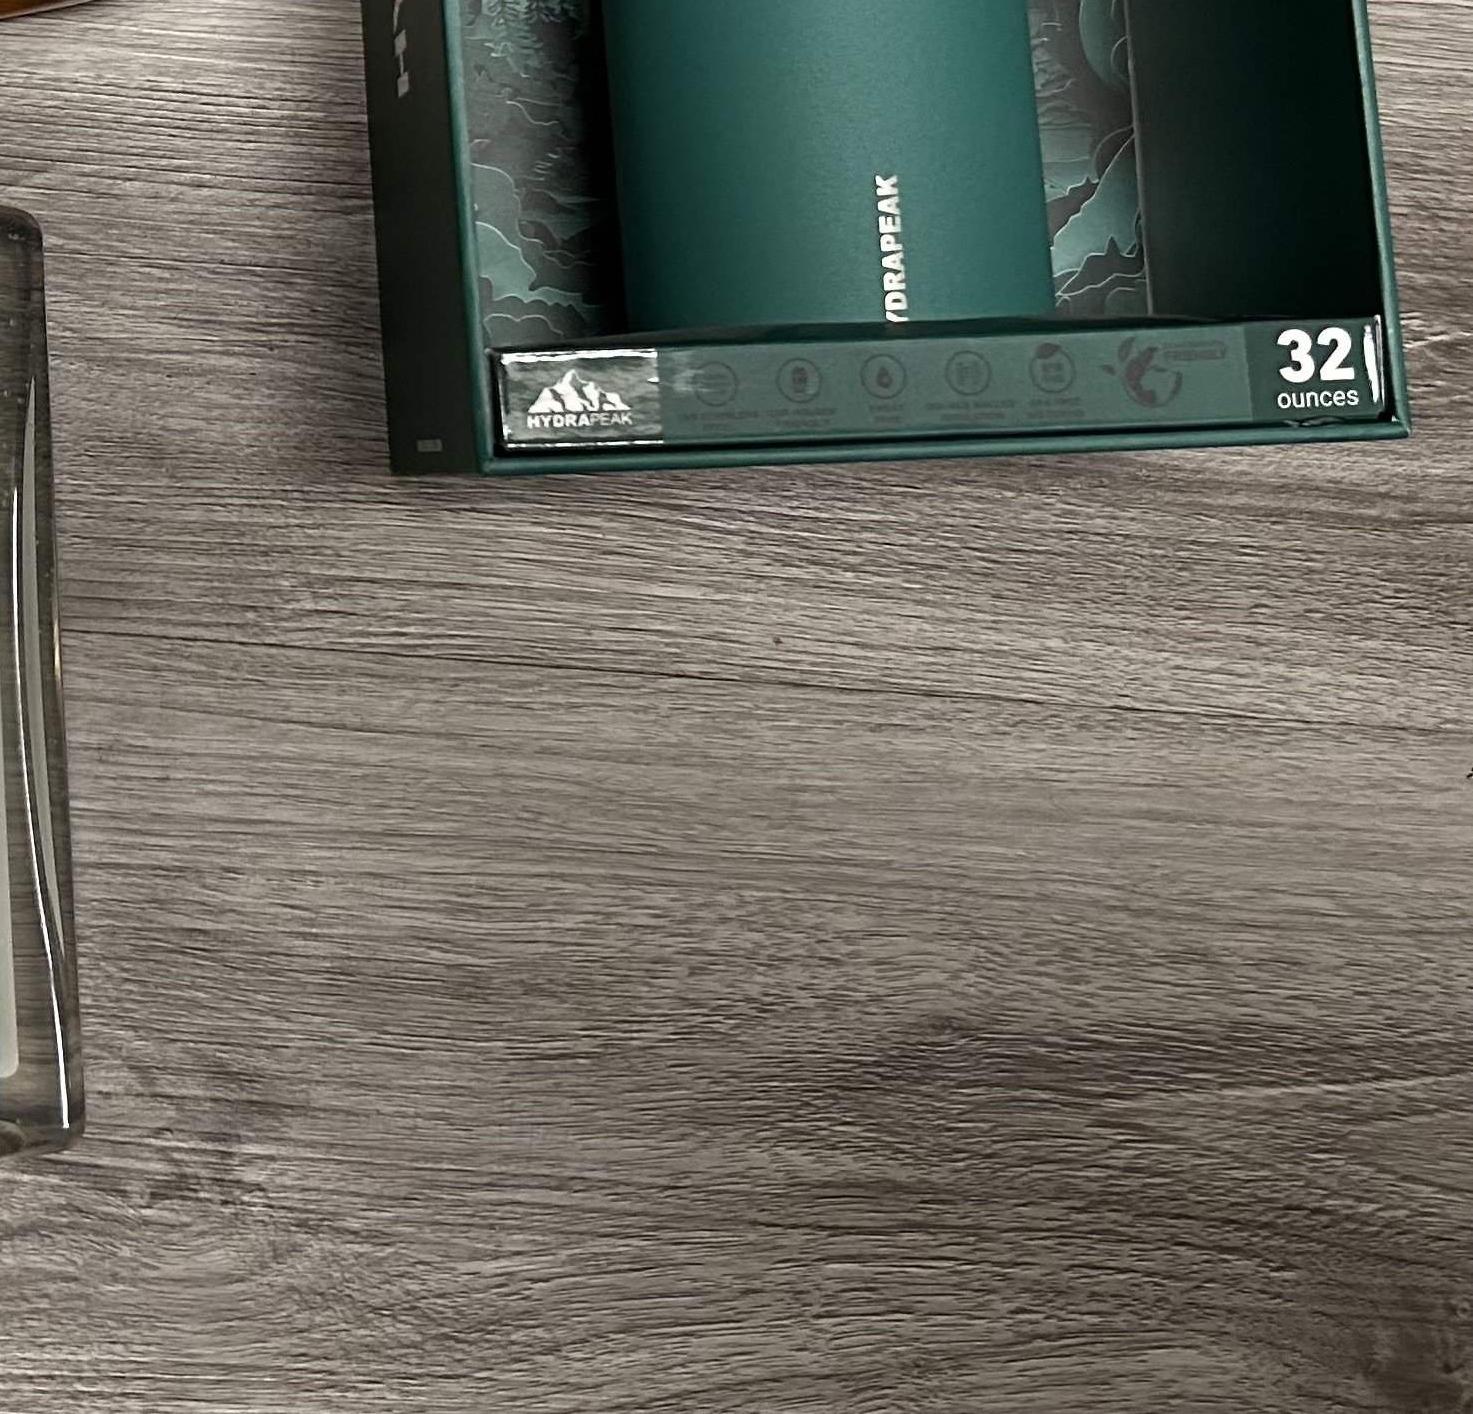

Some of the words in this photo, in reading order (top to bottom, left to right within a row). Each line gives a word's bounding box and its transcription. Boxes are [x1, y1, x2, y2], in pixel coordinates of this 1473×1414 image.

[874, 174, 909, 323] YDRAPEAK
[1277, 327, 1355, 383] 32
[1277, 390, 1359, 409] ounces
[527, 411, 633, 429] HYDRAPEAK
